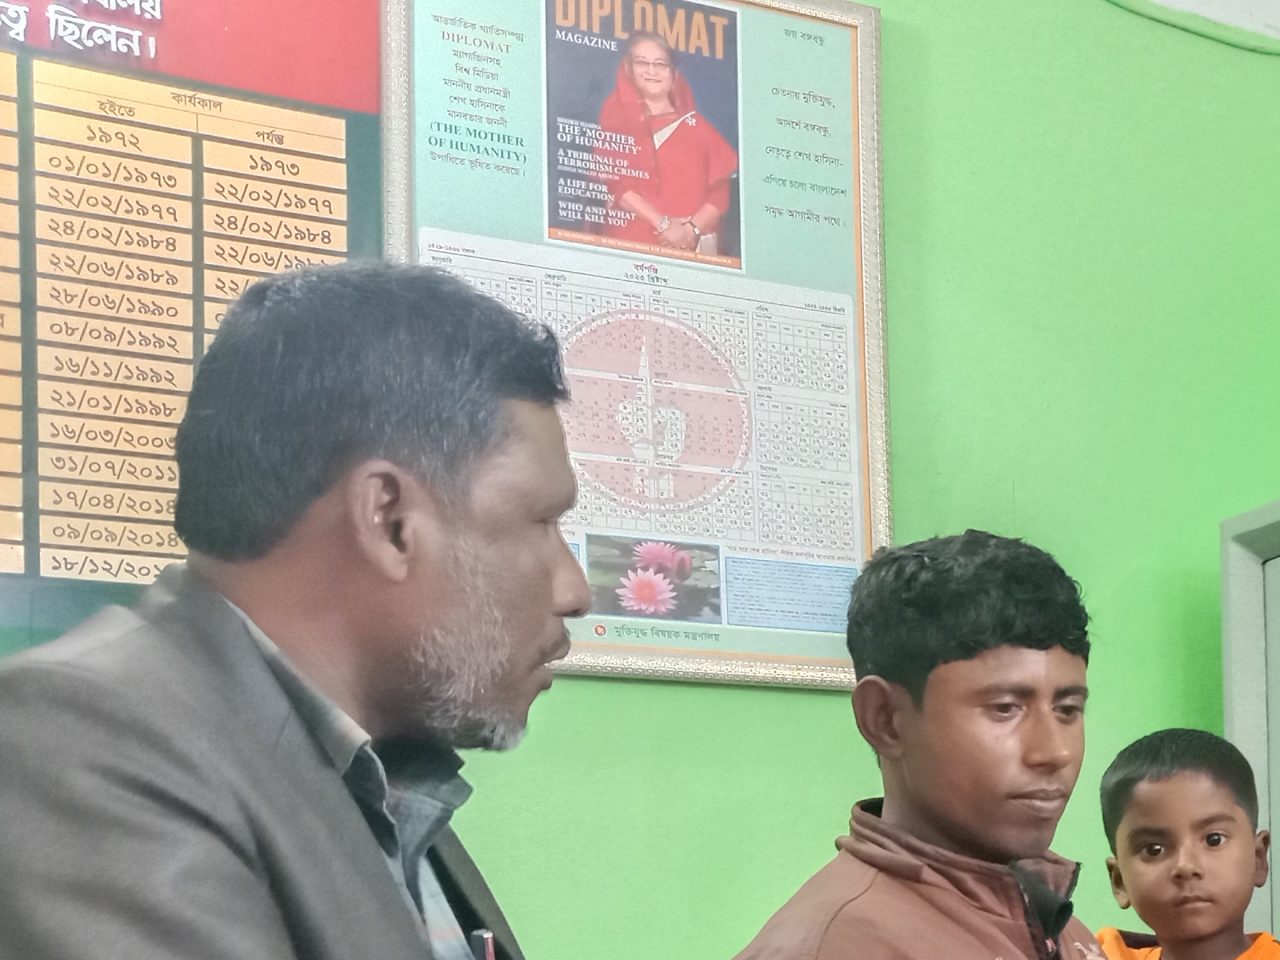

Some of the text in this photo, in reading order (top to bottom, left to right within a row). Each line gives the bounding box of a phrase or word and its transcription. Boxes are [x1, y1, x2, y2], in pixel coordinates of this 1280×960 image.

[441, 31, 512, 53] DIPLOMAT
[555, 29, 618, 51] MAGAZINE
[556, 0, 728, 59] DIPLOMAT
[97, 99, 136, 117] হইতে
[171, 91, 223, 113] কার্যকাল
[449, 95, 467, 104] শেখ
[430, 121, 525, 147] (THE MOTHER
[557, 123, 580, 135] THE
[557, 133, 573, 142] OF
[86, 125, 300, 176] ১৯৭২ ১৯৭৩
[428, 136, 527, 164] OF HUMANITY)
[558, 148, 629, 168] A TRIBUNAL OF
[558, 156, 650, 180] TERRORISM CRIMES
[48, 155, 333, 214] ০১/০১/১৯৭৩ ২২/০২/১৯৭৭
[558, 177, 609, 193] A LIFE FOR
[558, 186, 615, 202] EDUCATION
[48, 186, 331, 244] ২২/০২/১৯৭৭ ২৪/০২/১৯৮৪
[558, 200, 636, 220] WHO AND WHAT
[558, 208, 582, 220] WILL
[585, 213, 606, 225] KILL
[608, 217, 628, 228] YOU
[48, 218, 177, 252] ২৪/০২/১৯৮৪
[48, 253, 178, 286] ২২/০৬/১৯৮৯
[49, 286, 178, 318] ২৮/০৬/১৯৯০
[50, 321, 180, 353] ০৮/০৯/১৯৯২
[54, 355, 178, 388] ১৬/১১/১৯৯২
[50, 389, 177, 418] ২১/০১/১৯৯৮
[51, 455, 177, 482] ৩১/০৭/২০১১
[52, 522, 178, 547] ০৯/০৯/২০১৪
